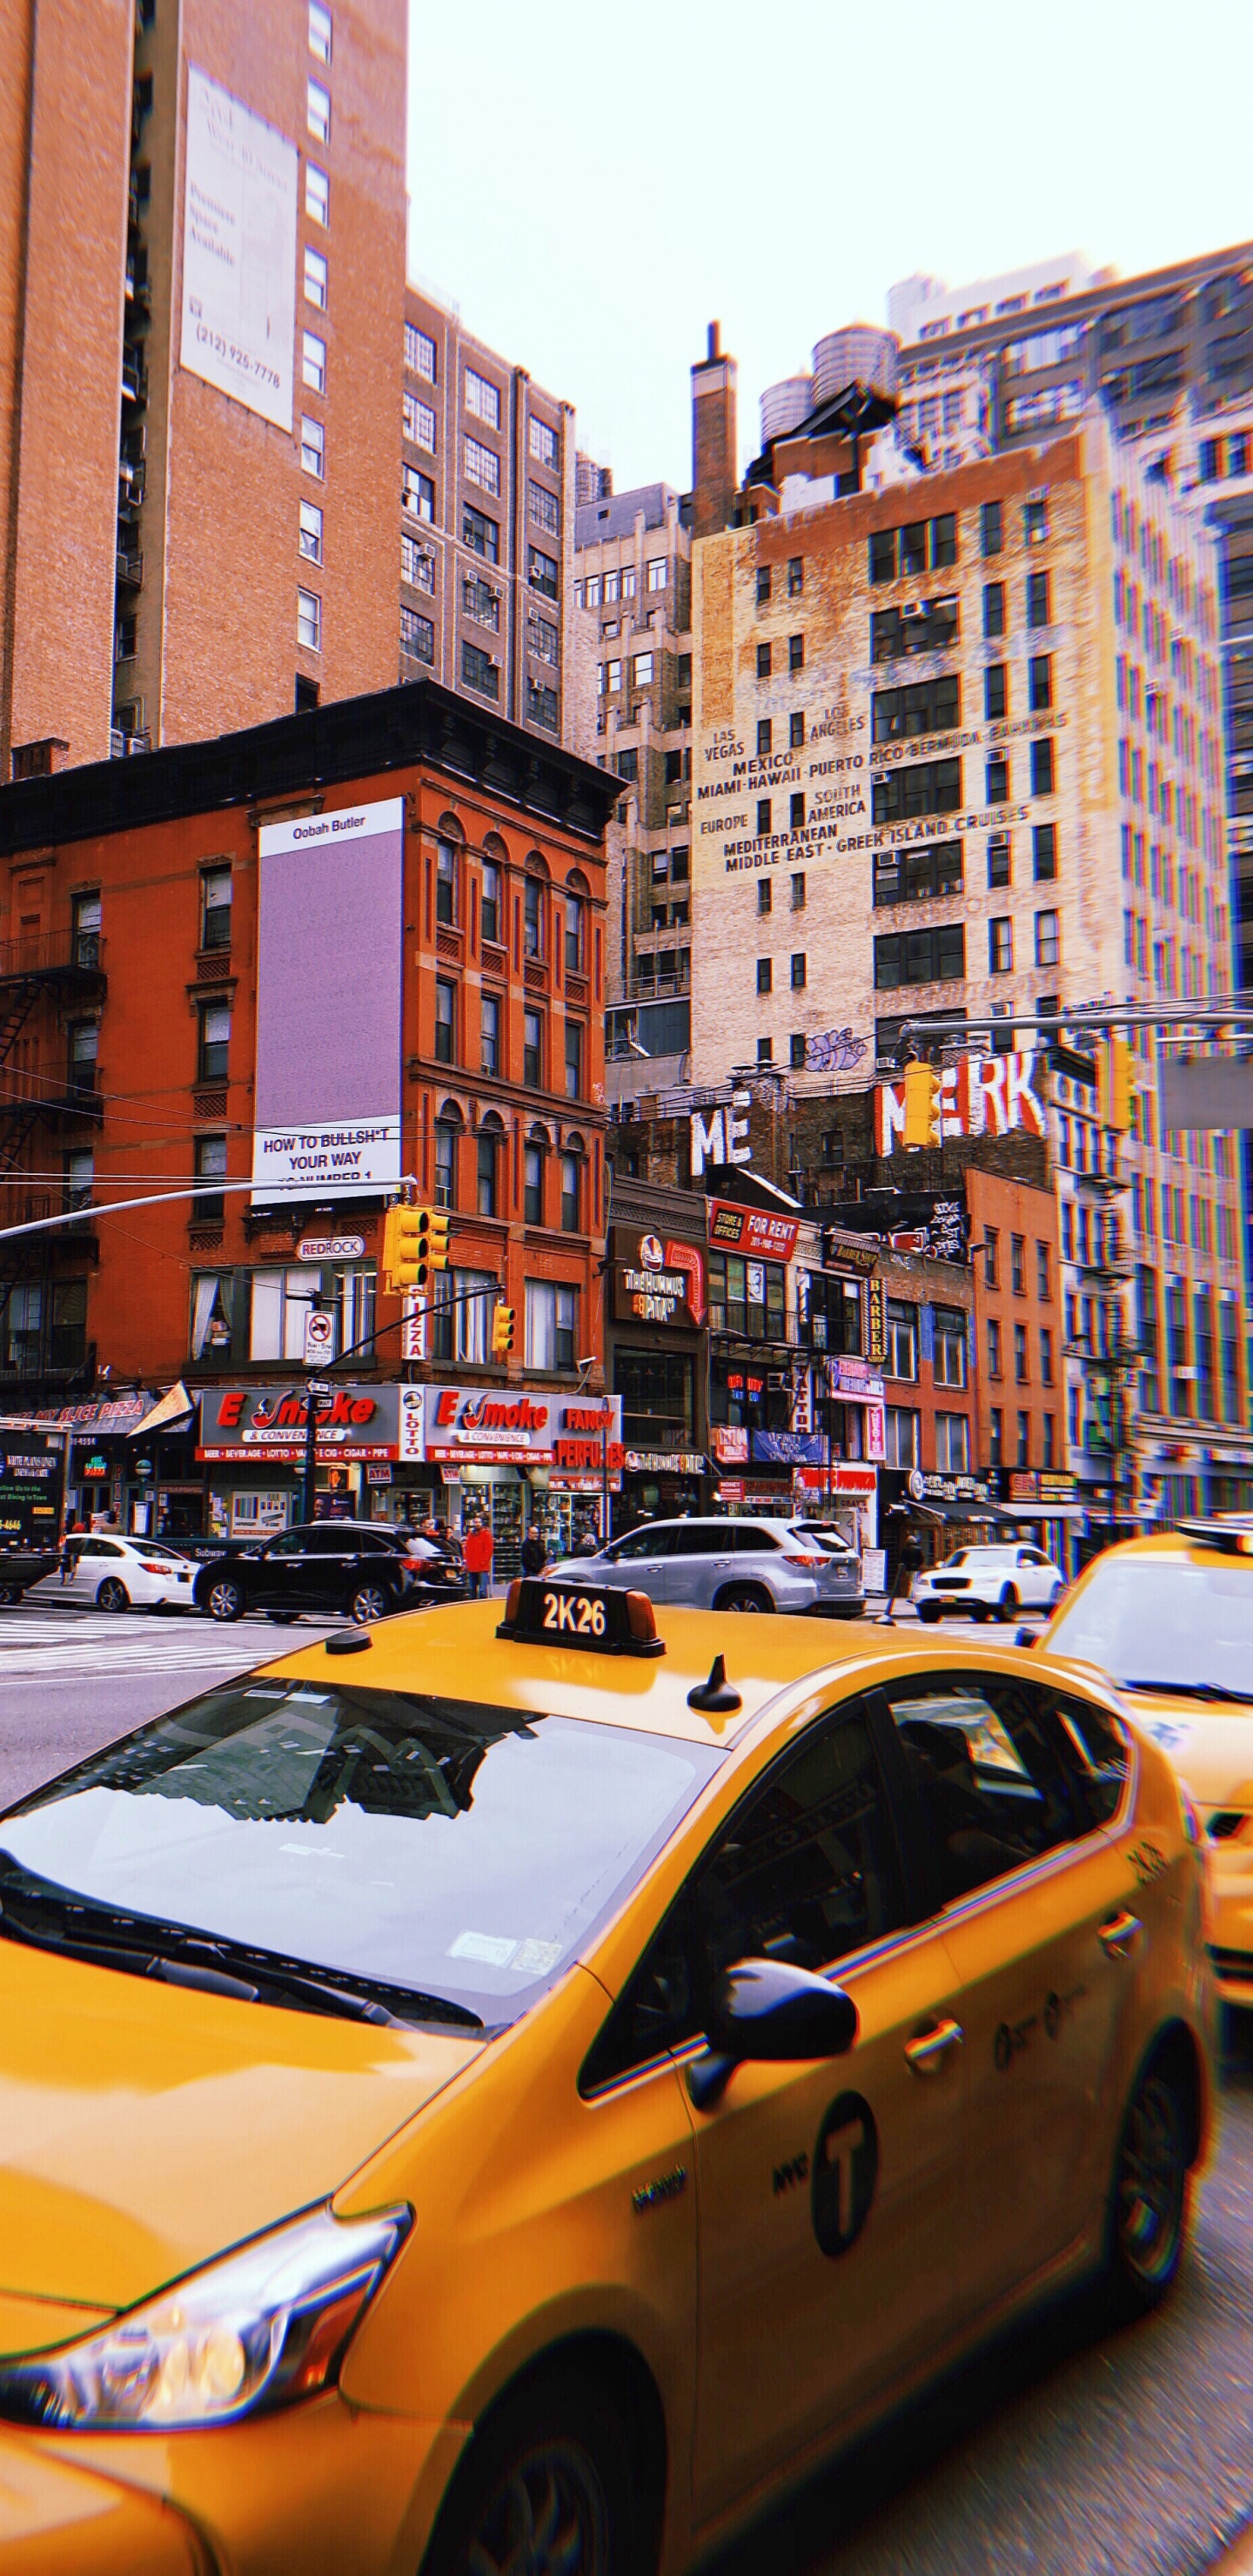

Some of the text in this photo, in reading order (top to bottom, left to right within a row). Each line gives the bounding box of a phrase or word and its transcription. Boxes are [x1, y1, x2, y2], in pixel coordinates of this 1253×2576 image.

[190, 223, 236, 266] Available
[197, 322, 226, 357] (212)
[824, 704, 850, 720] LOS
[713, 729, 736, 744] LAS
[810, 715, 866, 741] ANGELES
[705, 741, 746, 761] VEGAS
[733, 751, 794, 776] MEXICO
[814, 784, 861, 806] SOUTH
[807, 800, 867, 824] AMERICA
[292, 815, 365, 840] Oobah Butler
[700, 814, 749, 835] EUROPE
[723, 823, 838, 857] MEDITERRANEAN
[725, 850, 781, 873] MIDDLE
[786, 842, 825, 862] EAST
[836, 830, 885, 853] GREEK
[889, 821, 948, 844] ISLAND
[263, 1137, 297, 1153] HOW
[298, 1136, 318, 1150] TO
[289, 1150, 362, 1171] YOUR WAY
[717, 1212, 737, 1226] STORE
[747, 1214, 795, 1241] FOR RENT
[714, 1224, 740, 1239] OFFICES
[302, 1241, 358, 1256] REDROCK
[869, 1279, 882, 1356] BARBER
[57, 1403, 98, 1423] SLICE
[98, 1399, 144, 1419] PIZZA
[217, 1392, 245, 1426] E
[436, 1391, 460, 1426] E
[566, 1408, 615, 1432] FANCY
[249, 1429, 338, 1440] & CONVENNCE
[405, 1412, 420, 1455] LOTTO
[463, 1432, 526, 1443] & CONVENIENCE
[204, 1449, 220, 1458] BEER
[225, 1449, 262, 1458] BEVERAGE
[266, 1449, 290, 1458] LOTTO
[344, 1448, 367, 1457] CIGAR
[372, 1448, 388, 1457] PIPE
[478, 1451, 493, 1459] LOTTO
[557, 1439, 626, 1470] PERFUES
[369, 1468, 391, 1479] ATM
[443, 1468, 459, 1479] ATM
[194, 1546, 227, 1558] Subway
[542, 1593, 606, 1636] 2K26
[827, 2116, 864, 2237] T
